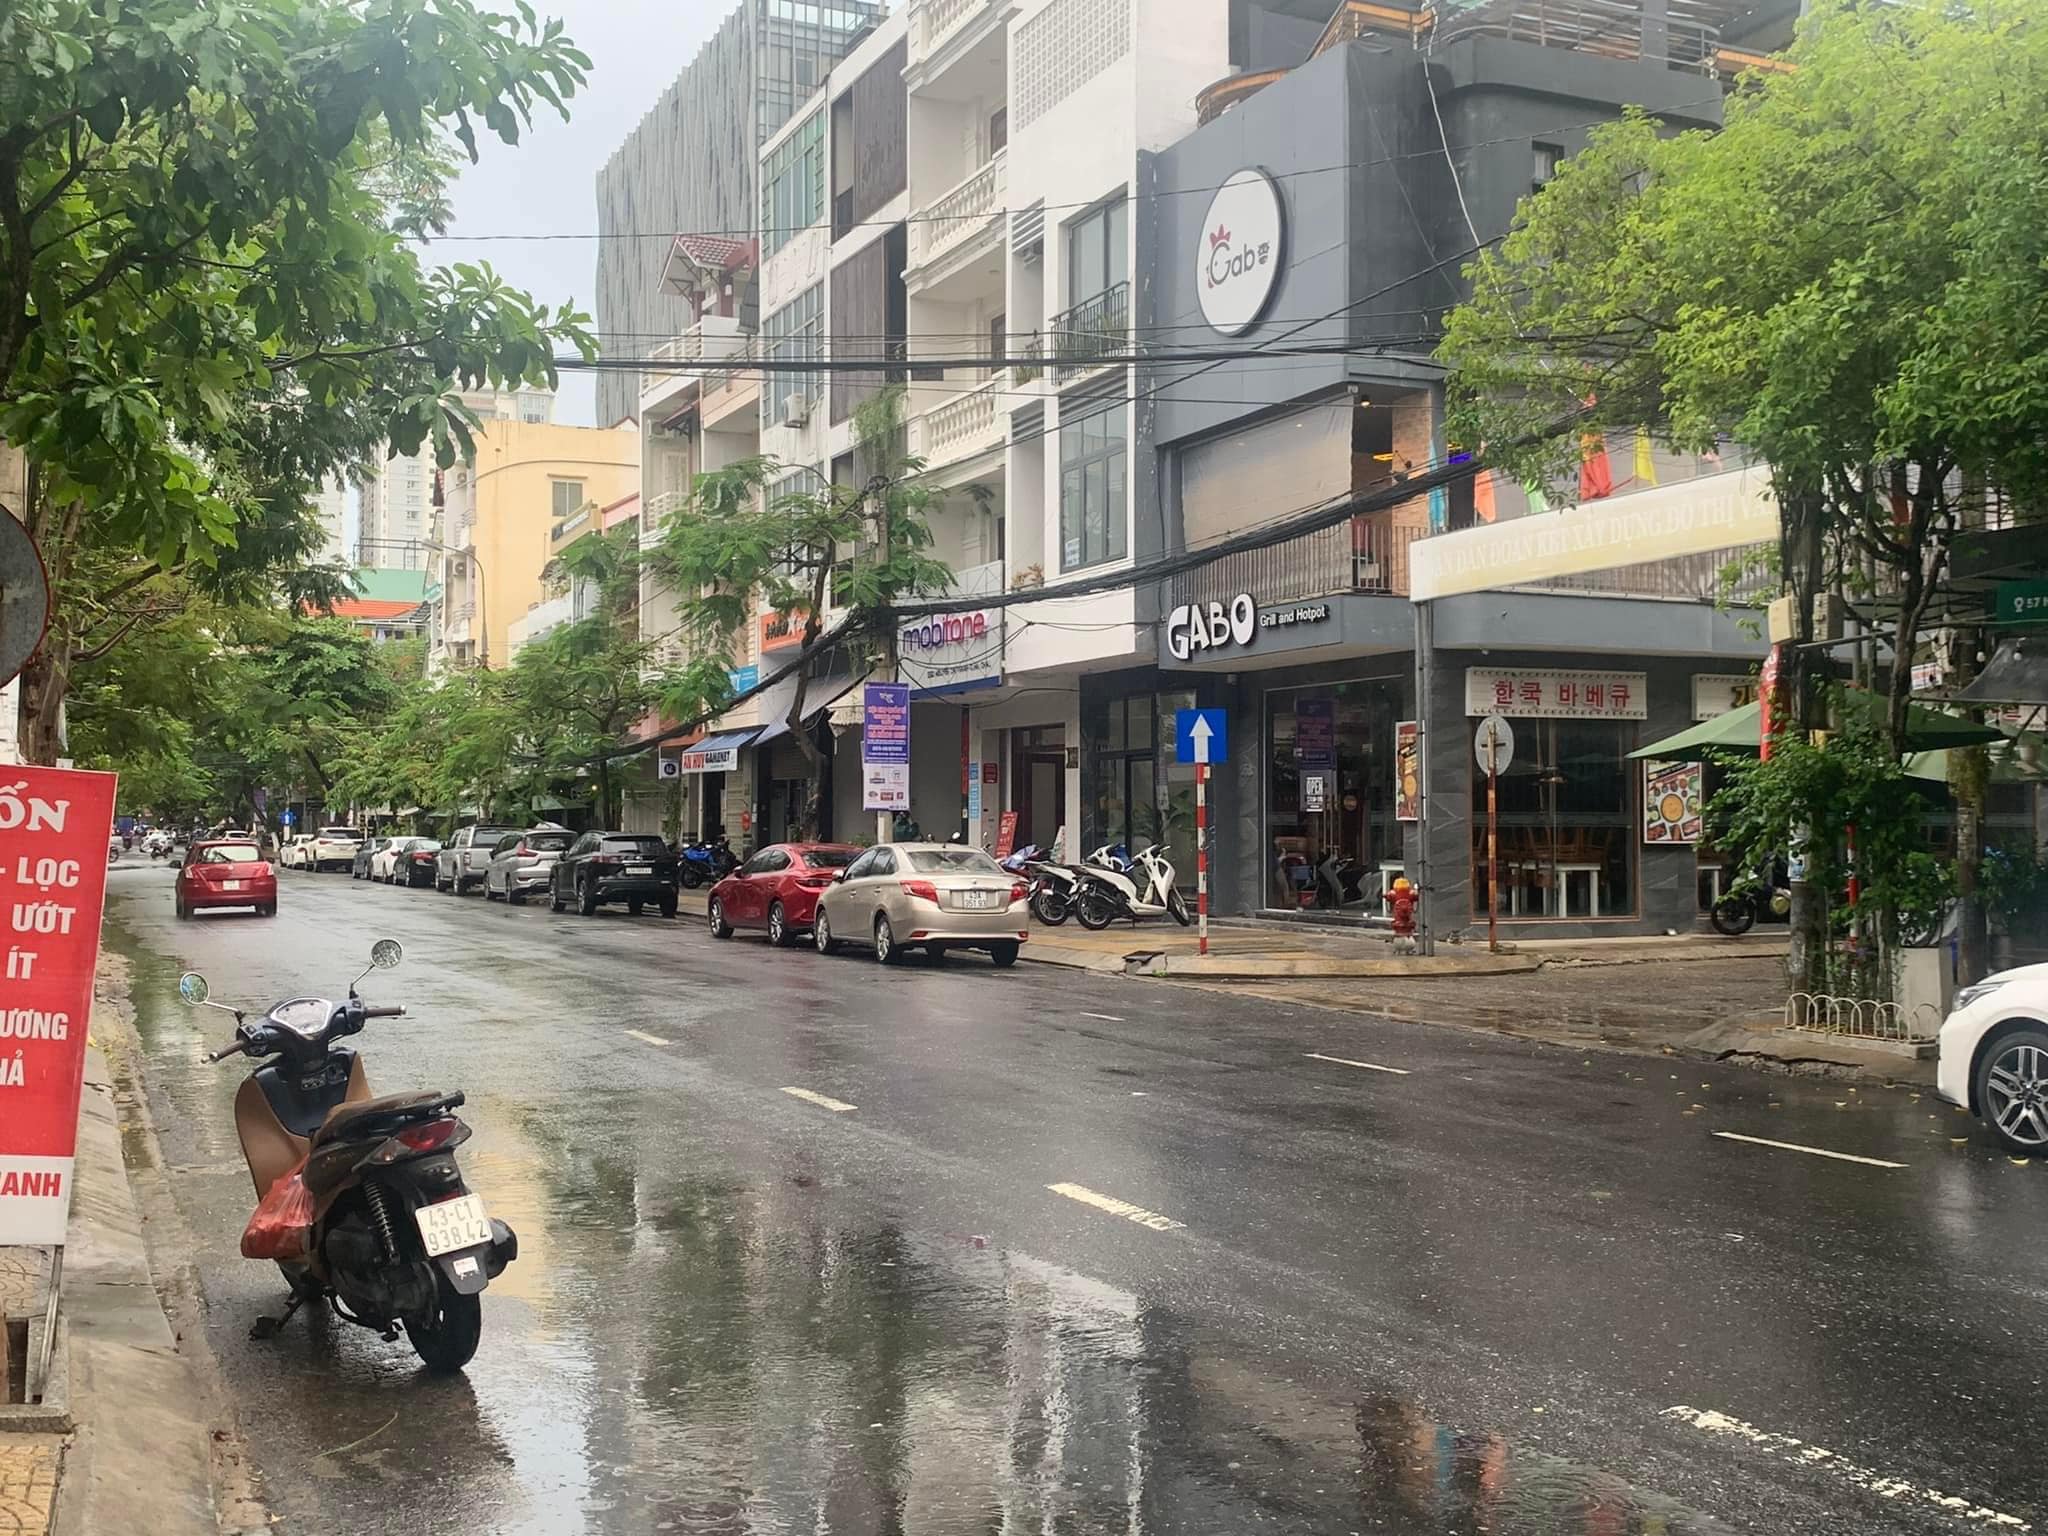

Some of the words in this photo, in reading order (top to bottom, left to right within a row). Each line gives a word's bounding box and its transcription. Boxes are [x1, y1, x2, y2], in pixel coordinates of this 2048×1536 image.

[2026, 597, 2041, 609] 57
[1168, 593, 1255, 660] GABO
[1260, 613, 1276, 627] Grill
[1278, 610, 1294, 623] and
[1296, 605, 1326, 624] Hotpot
[1494, 681, 1542, 707] 한국
[1558, 683, 1631, 708] 바베큐
[16, 856, 80, 892] LỌC
[12, 900, 76, 934] ƯỚT
[6, 945, 38, 980] ÍT
[0, 1171, 61, 1197] ANH
[428, 1200, 473, 1228] 43-C1
[427, 1220, 487, 1251] 938.42
